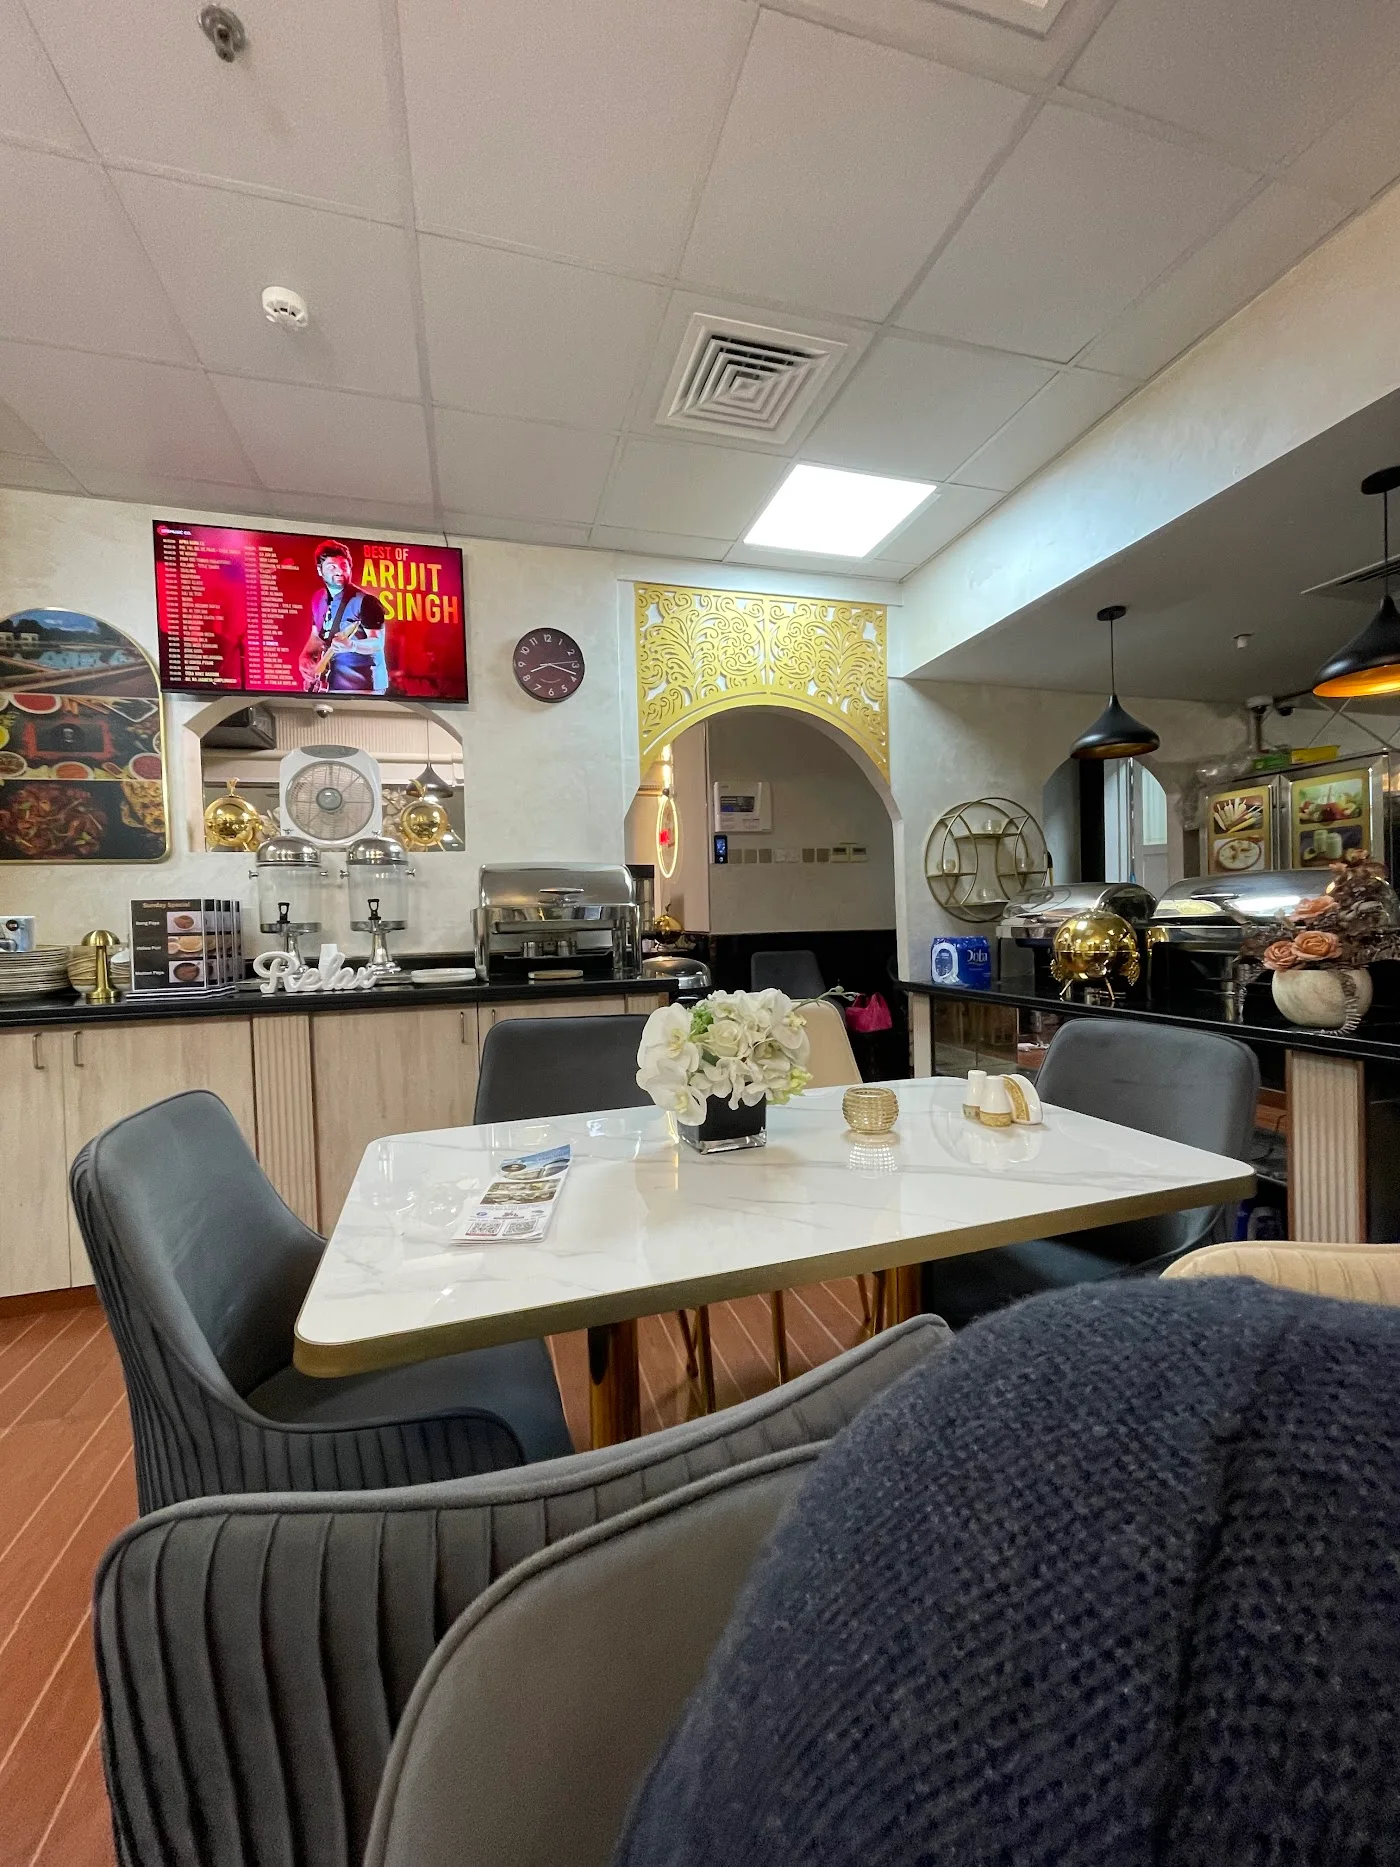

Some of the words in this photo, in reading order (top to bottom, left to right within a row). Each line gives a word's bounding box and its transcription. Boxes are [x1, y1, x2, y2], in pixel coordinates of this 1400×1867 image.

[363, 545, 391, 559] BEST
[395, 548, 409, 561] OF
[361, 558, 442, 592] ARIJIT
[379, 590, 459, 624] SINGH
[529, 637, 538, 646] 11
[543, 634, 552, 643] 12
[558, 638, 563, 646] 1
[520, 646, 530, 655] 10
[522, 674, 531, 682] 8
[533, 683, 542, 691] 7
[561, 684, 568, 693] 5
[548, 688, 554, 696] 6
[253, 951, 378, 993] Relax
